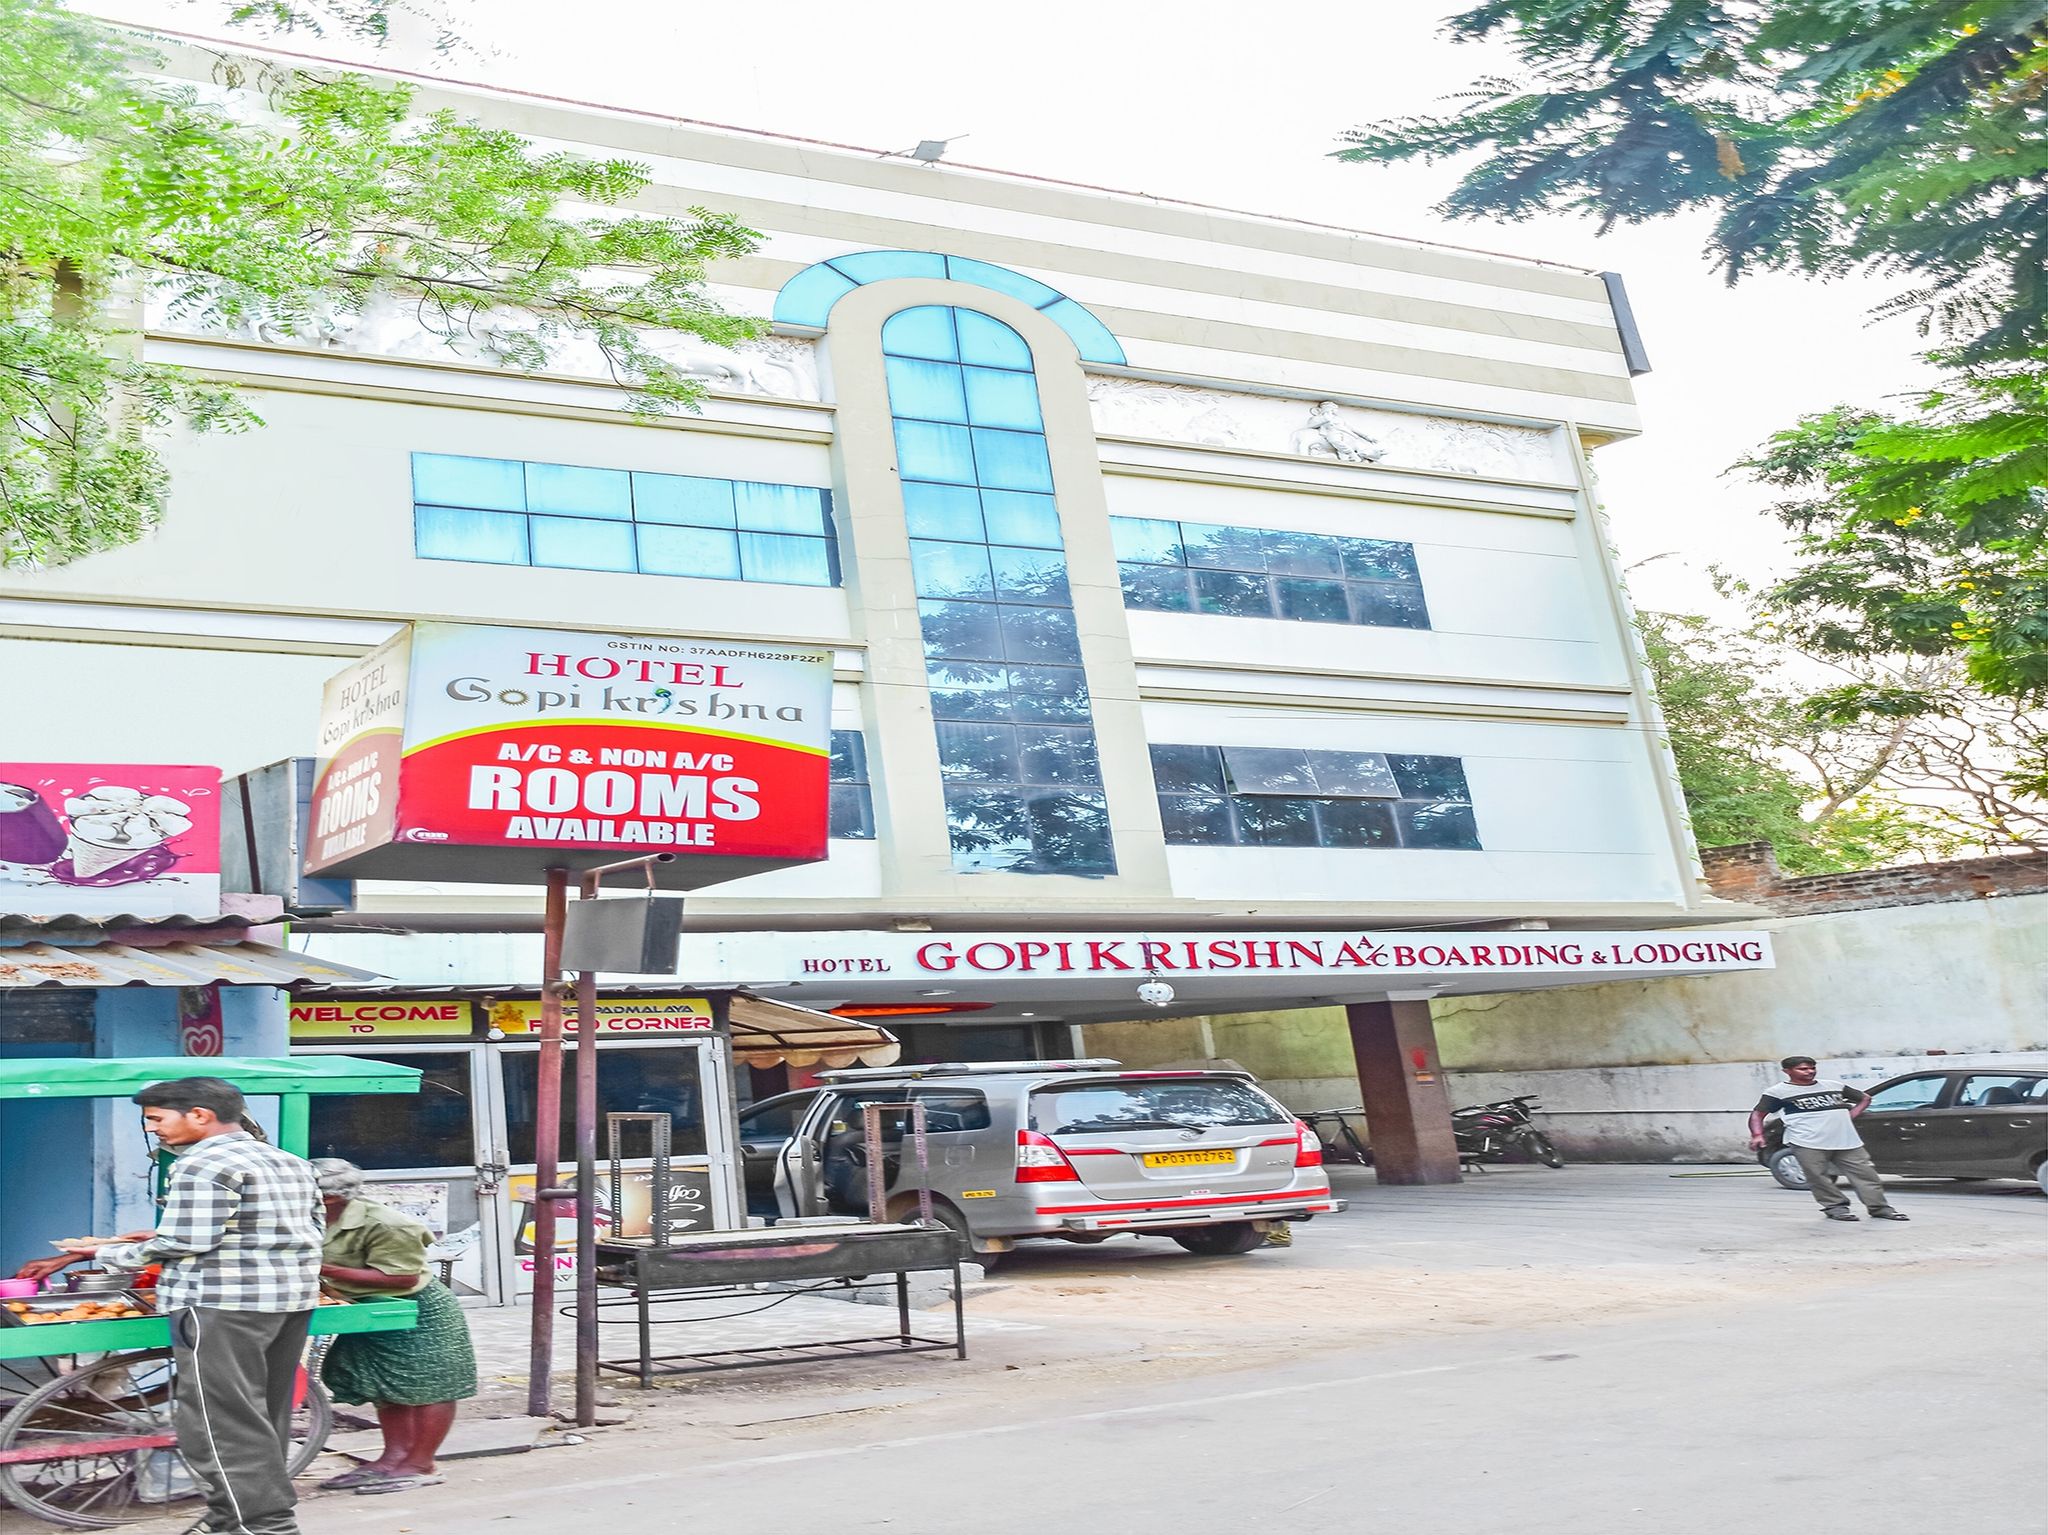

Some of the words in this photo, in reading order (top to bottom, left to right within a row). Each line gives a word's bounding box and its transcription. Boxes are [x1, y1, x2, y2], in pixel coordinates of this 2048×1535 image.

[607, 641, 653, 651] GSTIN
[658, 645, 685, 654] NO:
[523, 652, 745, 688] HOTEL
[340, 664, 388, 711] HOTEL
[446, 677, 580, 712] Gopi
[602, 686, 804, 722] krishna
[498, 743, 563, 763] A/C
[569, 749, 593, 765] &
[600, 748, 666, 768] NON
[674, 751, 734, 772] A/C
[317, 771, 381, 838] ROOMS
[468, 765, 760, 821] ROOMS
[322, 822, 367, 860] AVAILABLE
[505, 816, 716, 846] AVAILABLE
[802, 958, 891, 974] HOTEL
[917, 940, 1370, 972] GOPIKRISHNA
[1394, 944, 1583, 966] BOARDING
[1592, 951, 1607, 964] &
[1612, 941, 1764, 966] LODGING
[290, 1005, 459, 1021] WELCOME
[350, 1024, 375, 1033] TO
[608, 1017, 712, 1032] CORNER
